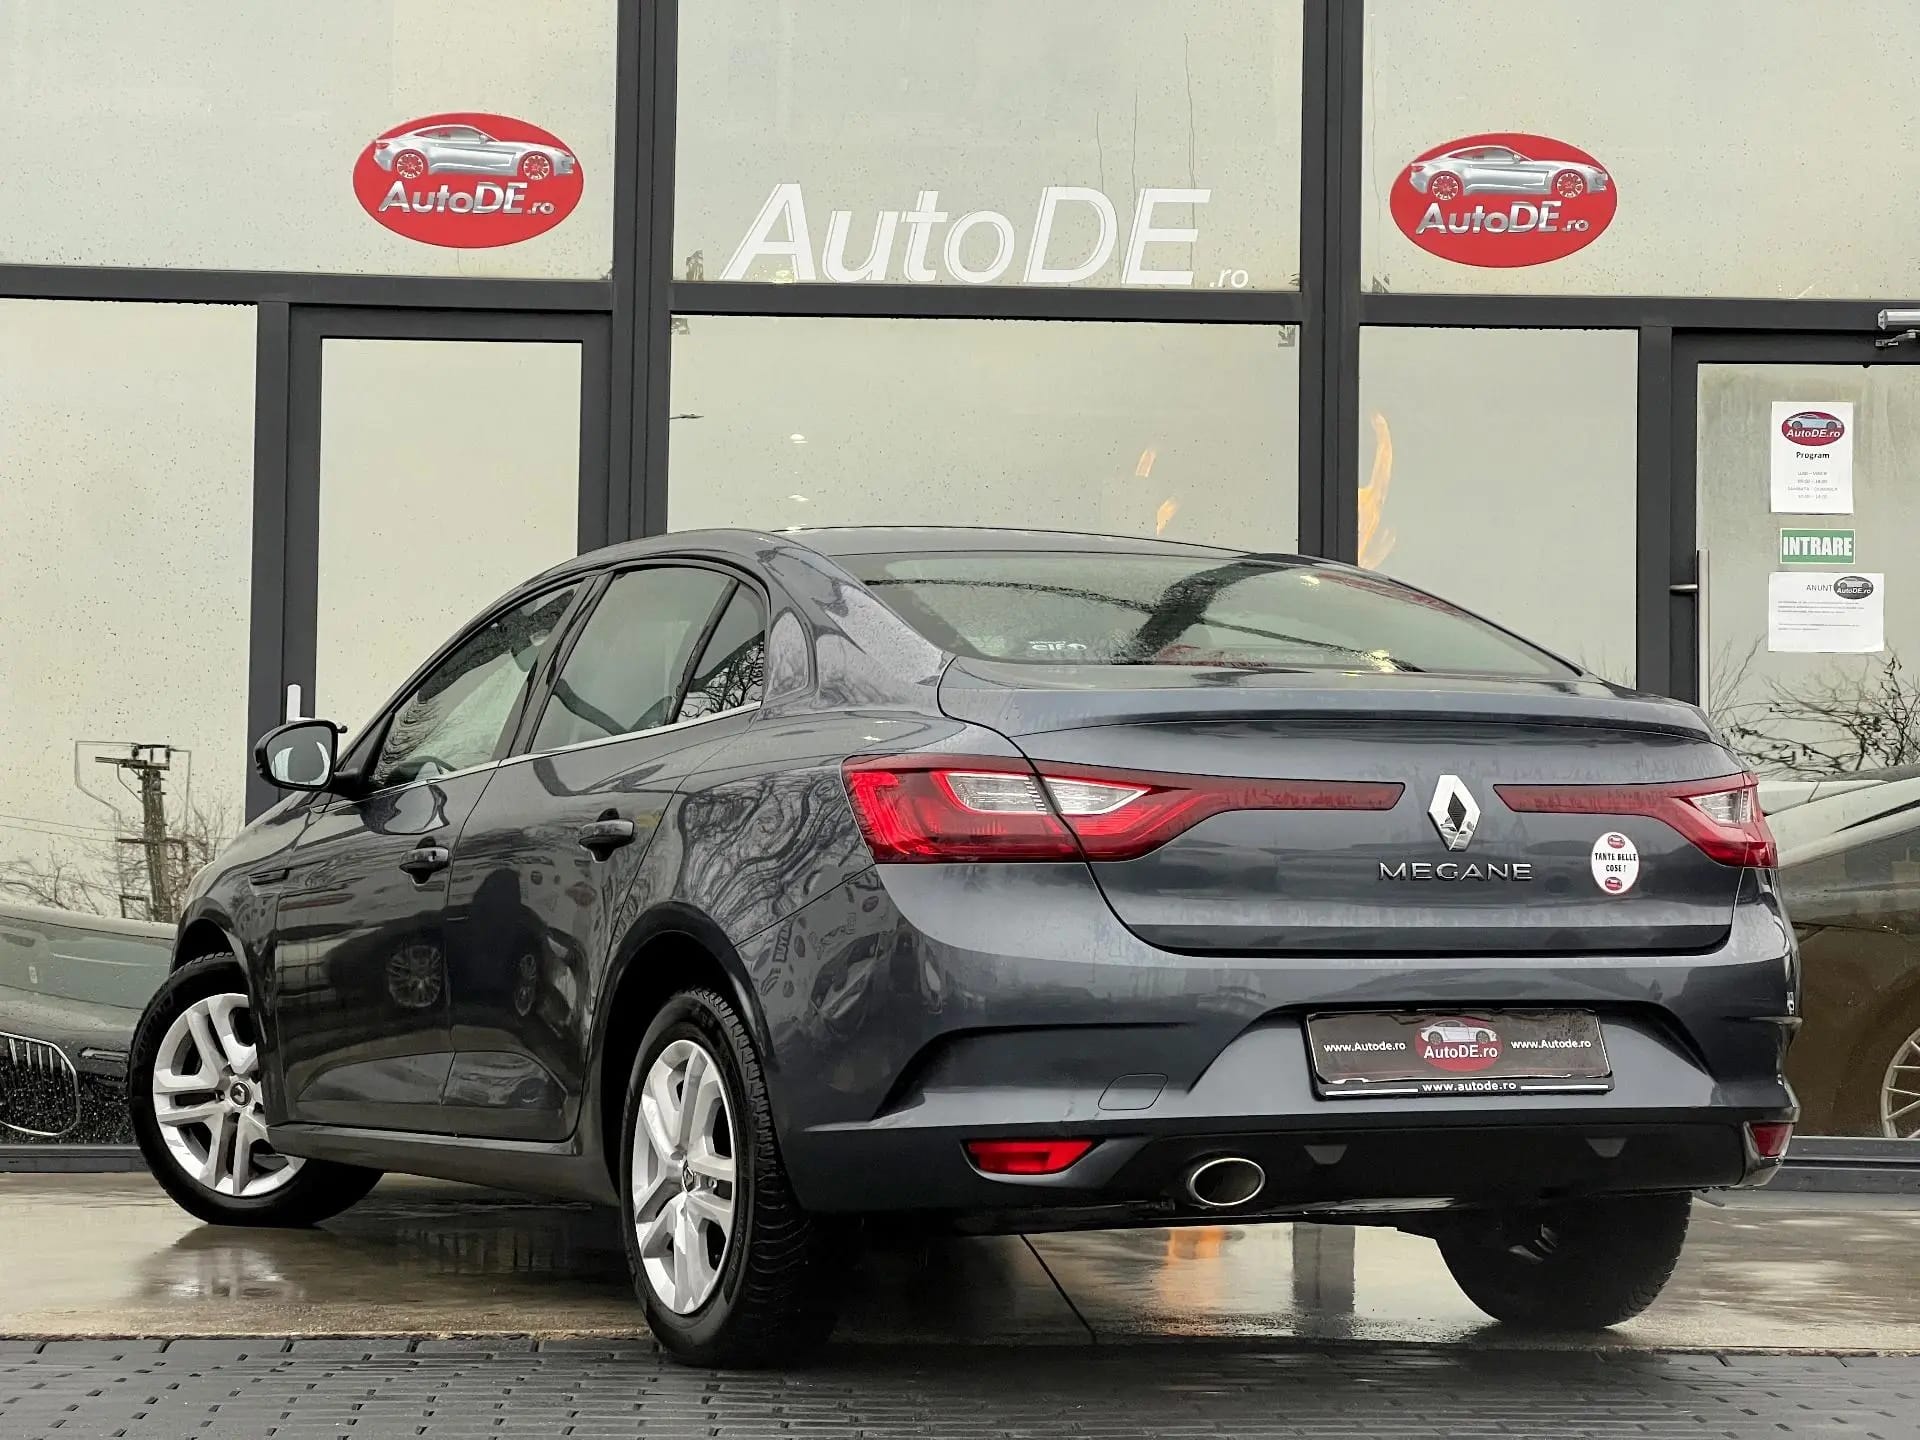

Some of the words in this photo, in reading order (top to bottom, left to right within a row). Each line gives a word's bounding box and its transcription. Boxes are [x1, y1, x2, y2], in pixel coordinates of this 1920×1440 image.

[1786, 428, 1841, 438] AutoDE.ro
[1796, 451, 1830, 460] Program
[1783, 536, 1853, 556] INTRARE
[1806, 584, 1833, 592] ANUNT
[1595, 852, 1616, 861] TANTE
[1617, 853, 1637, 862] BELLE
[1378, 862, 1534, 881] MEGANE
[1323, 1040, 1407, 1052] www.Autode.ro
[1510, 1037, 1592, 1049] www.Autode.ro
[1423, 1044, 1498, 1060] AutoDE.ro
[1421, 1079, 1517, 1093] www.autode.ro
